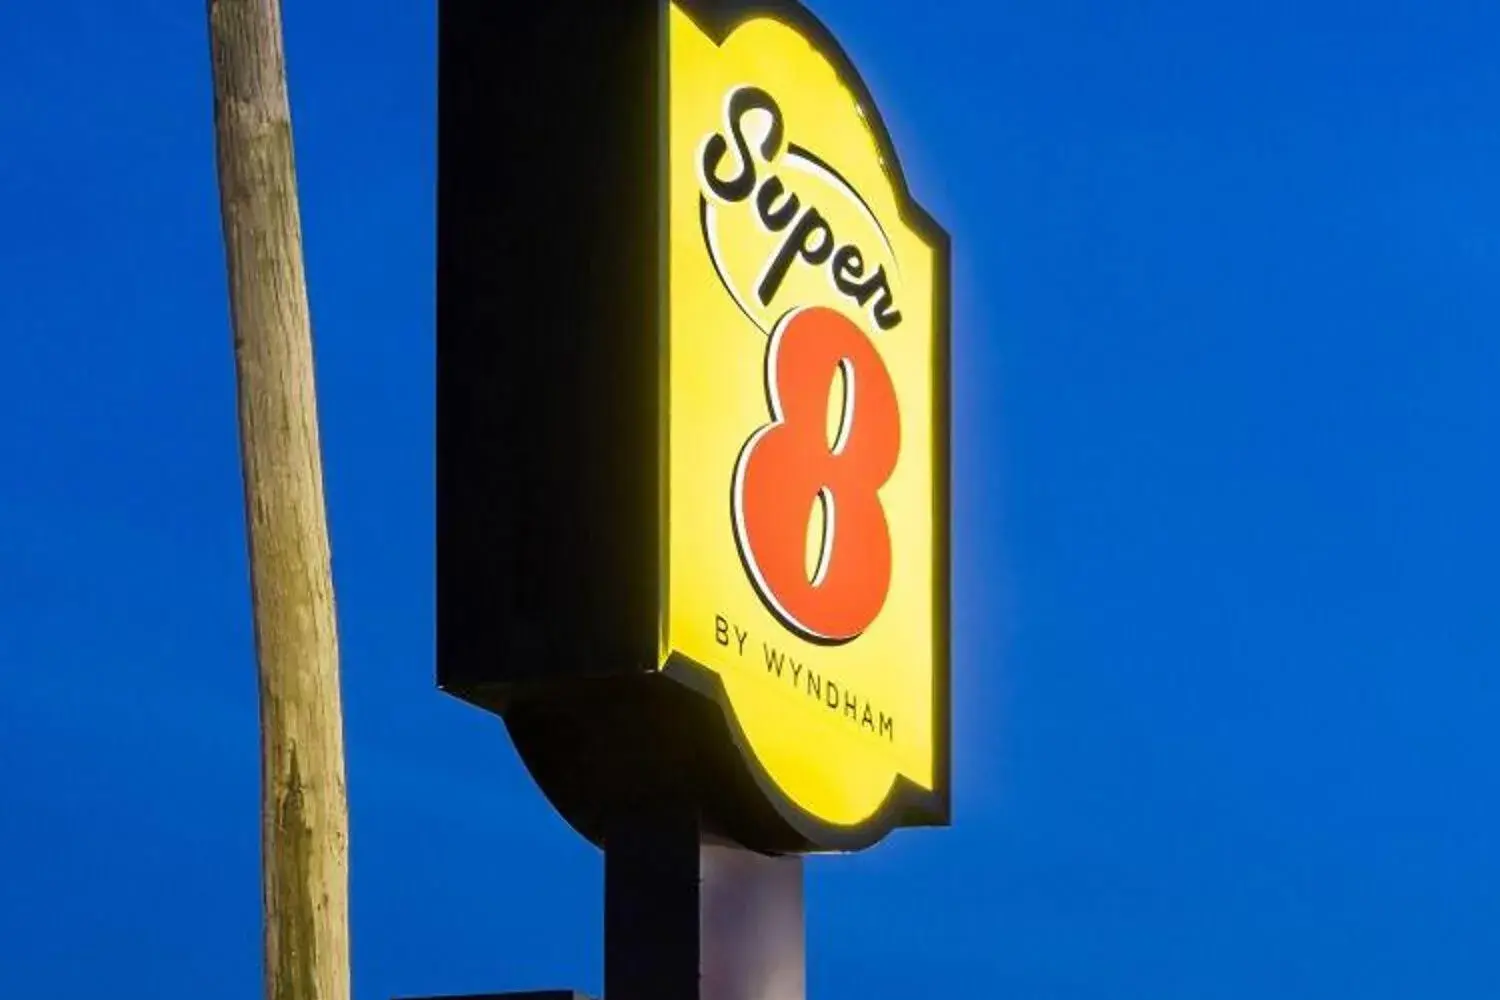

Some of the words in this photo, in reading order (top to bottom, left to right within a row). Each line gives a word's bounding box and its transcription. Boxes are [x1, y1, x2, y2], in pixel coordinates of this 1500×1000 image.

[702, 86, 902, 331] Super
[731, 305, 901, 646] 8
[715, 614, 747, 656] BY
[763, 642, 894, 742] WYNDHAM
